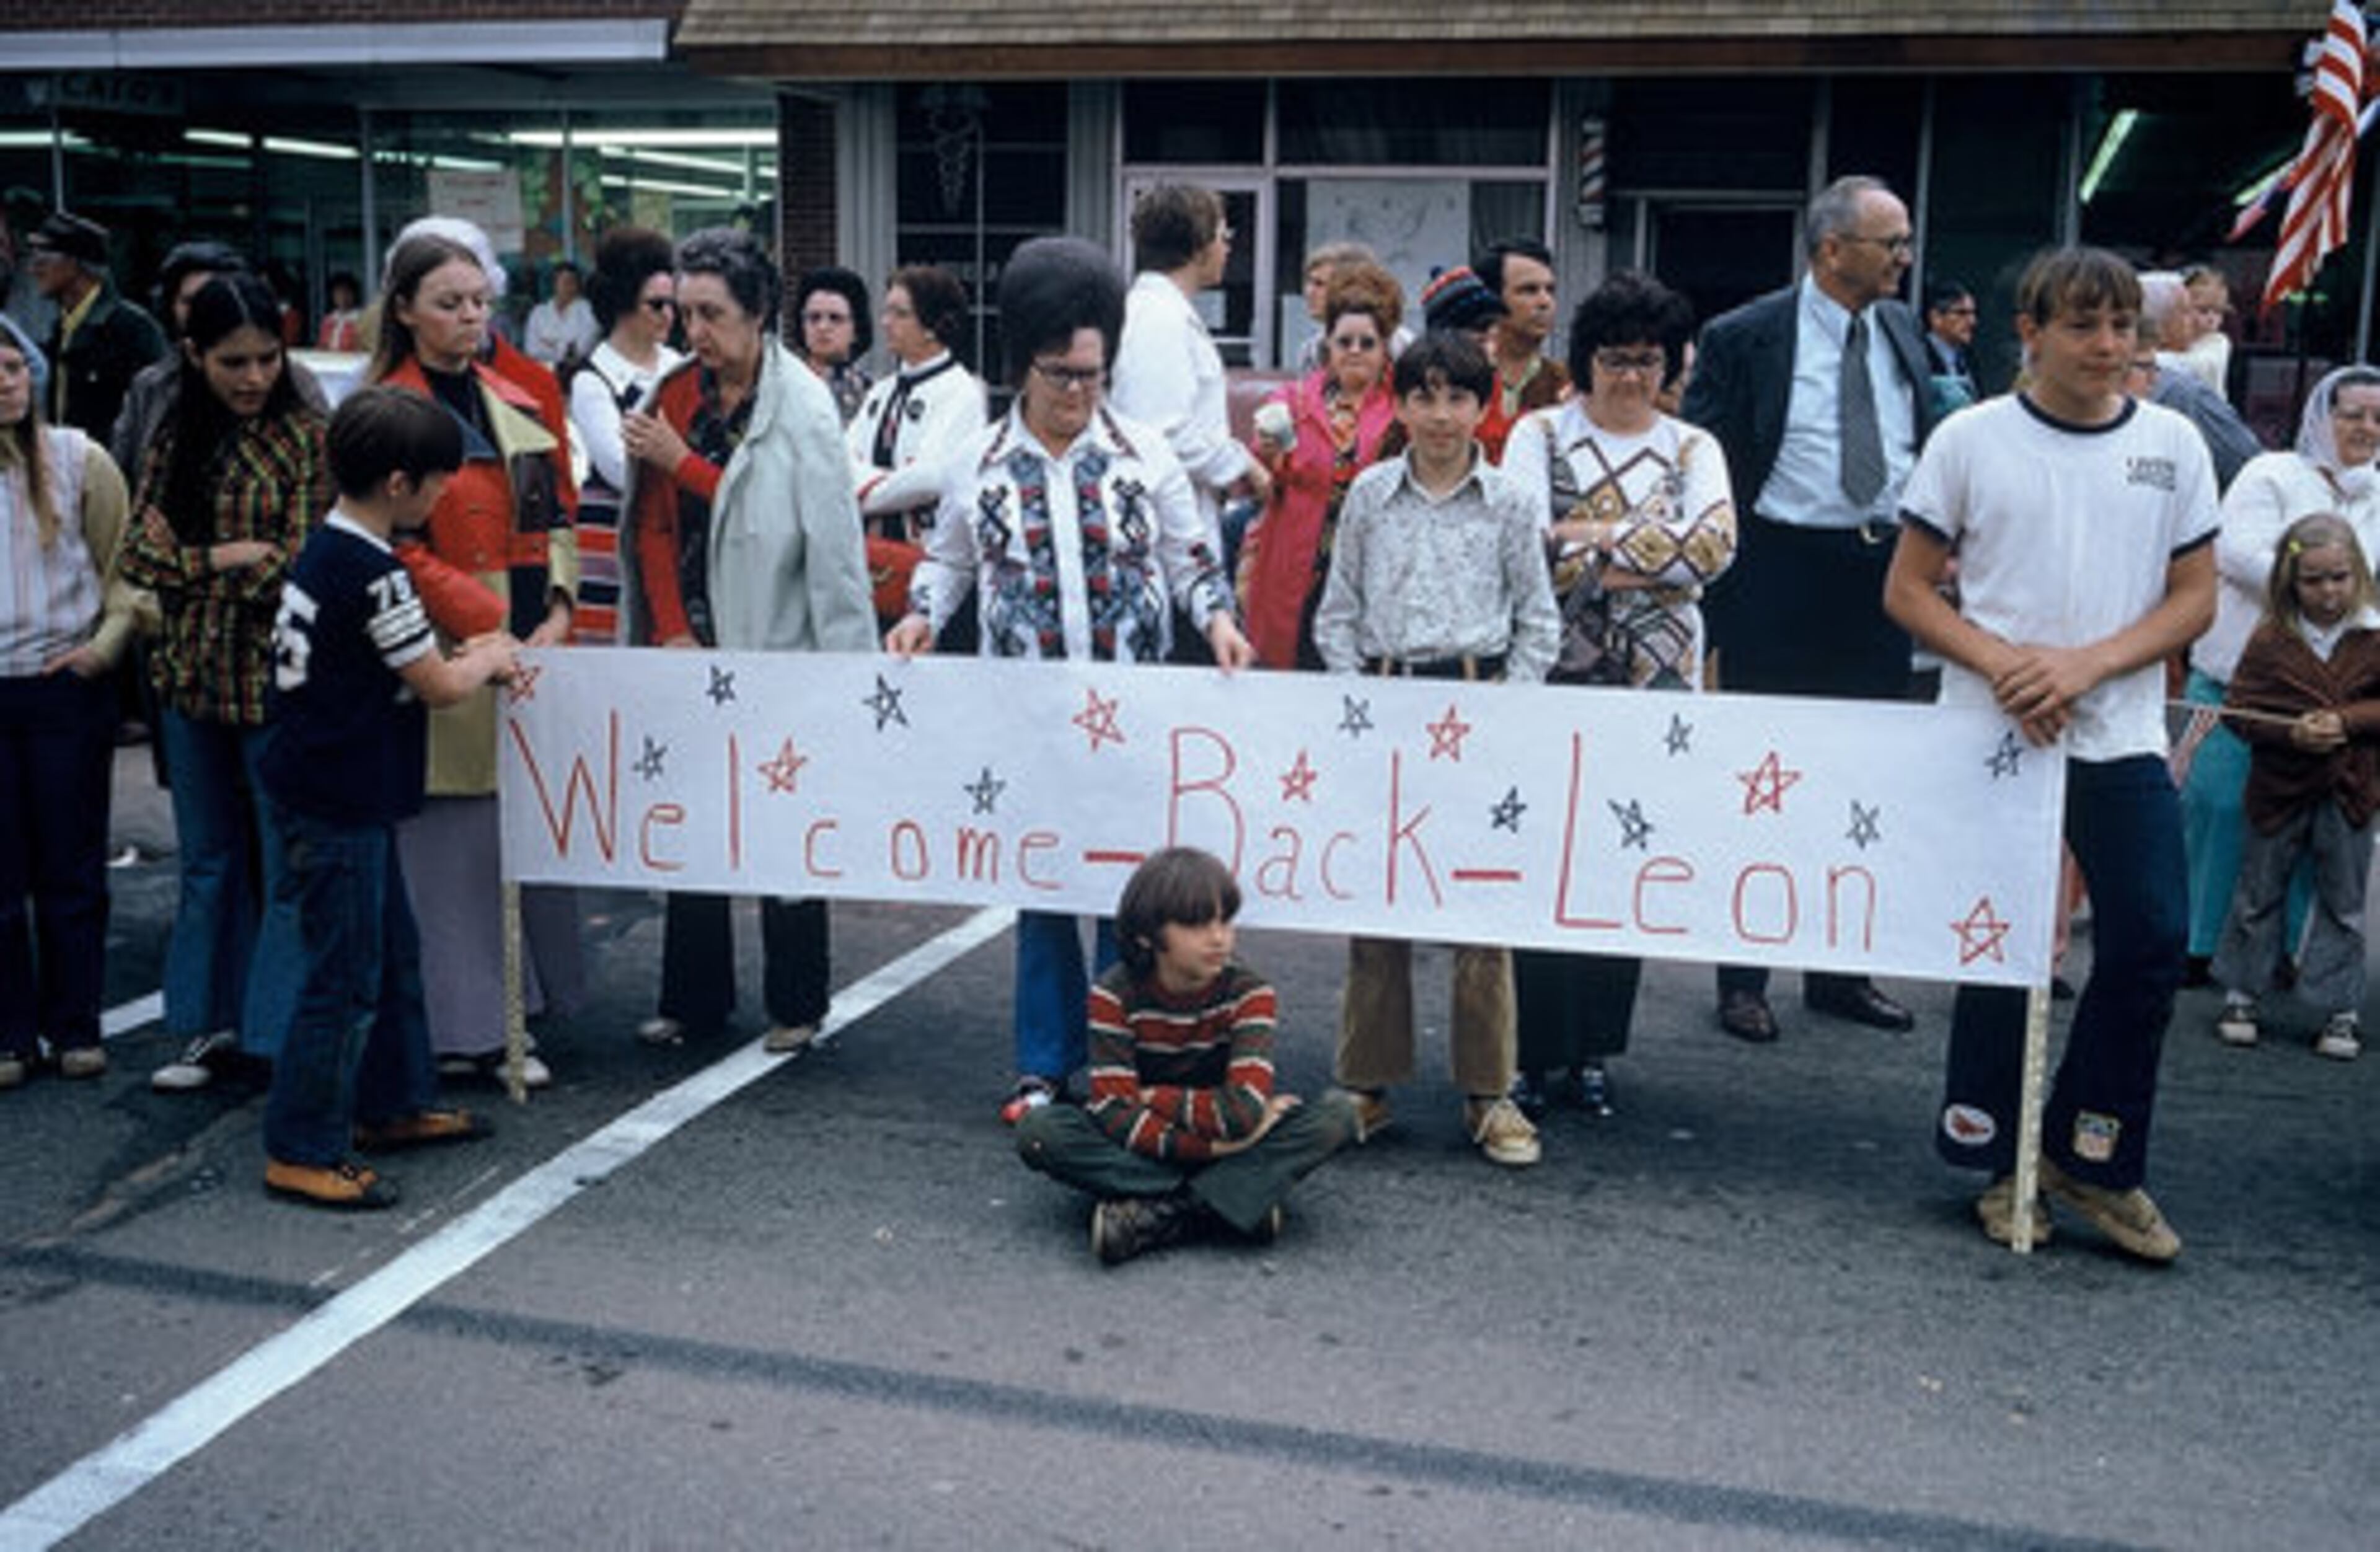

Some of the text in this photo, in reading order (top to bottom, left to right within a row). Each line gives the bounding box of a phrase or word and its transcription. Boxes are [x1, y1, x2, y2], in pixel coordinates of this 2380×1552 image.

[367, 569, 413, 612] 75
[508, 710, 1064, 891] Welcome
[1167, 726, 1443, 908] Back
[1554, 730, 1877, 953] Leon
